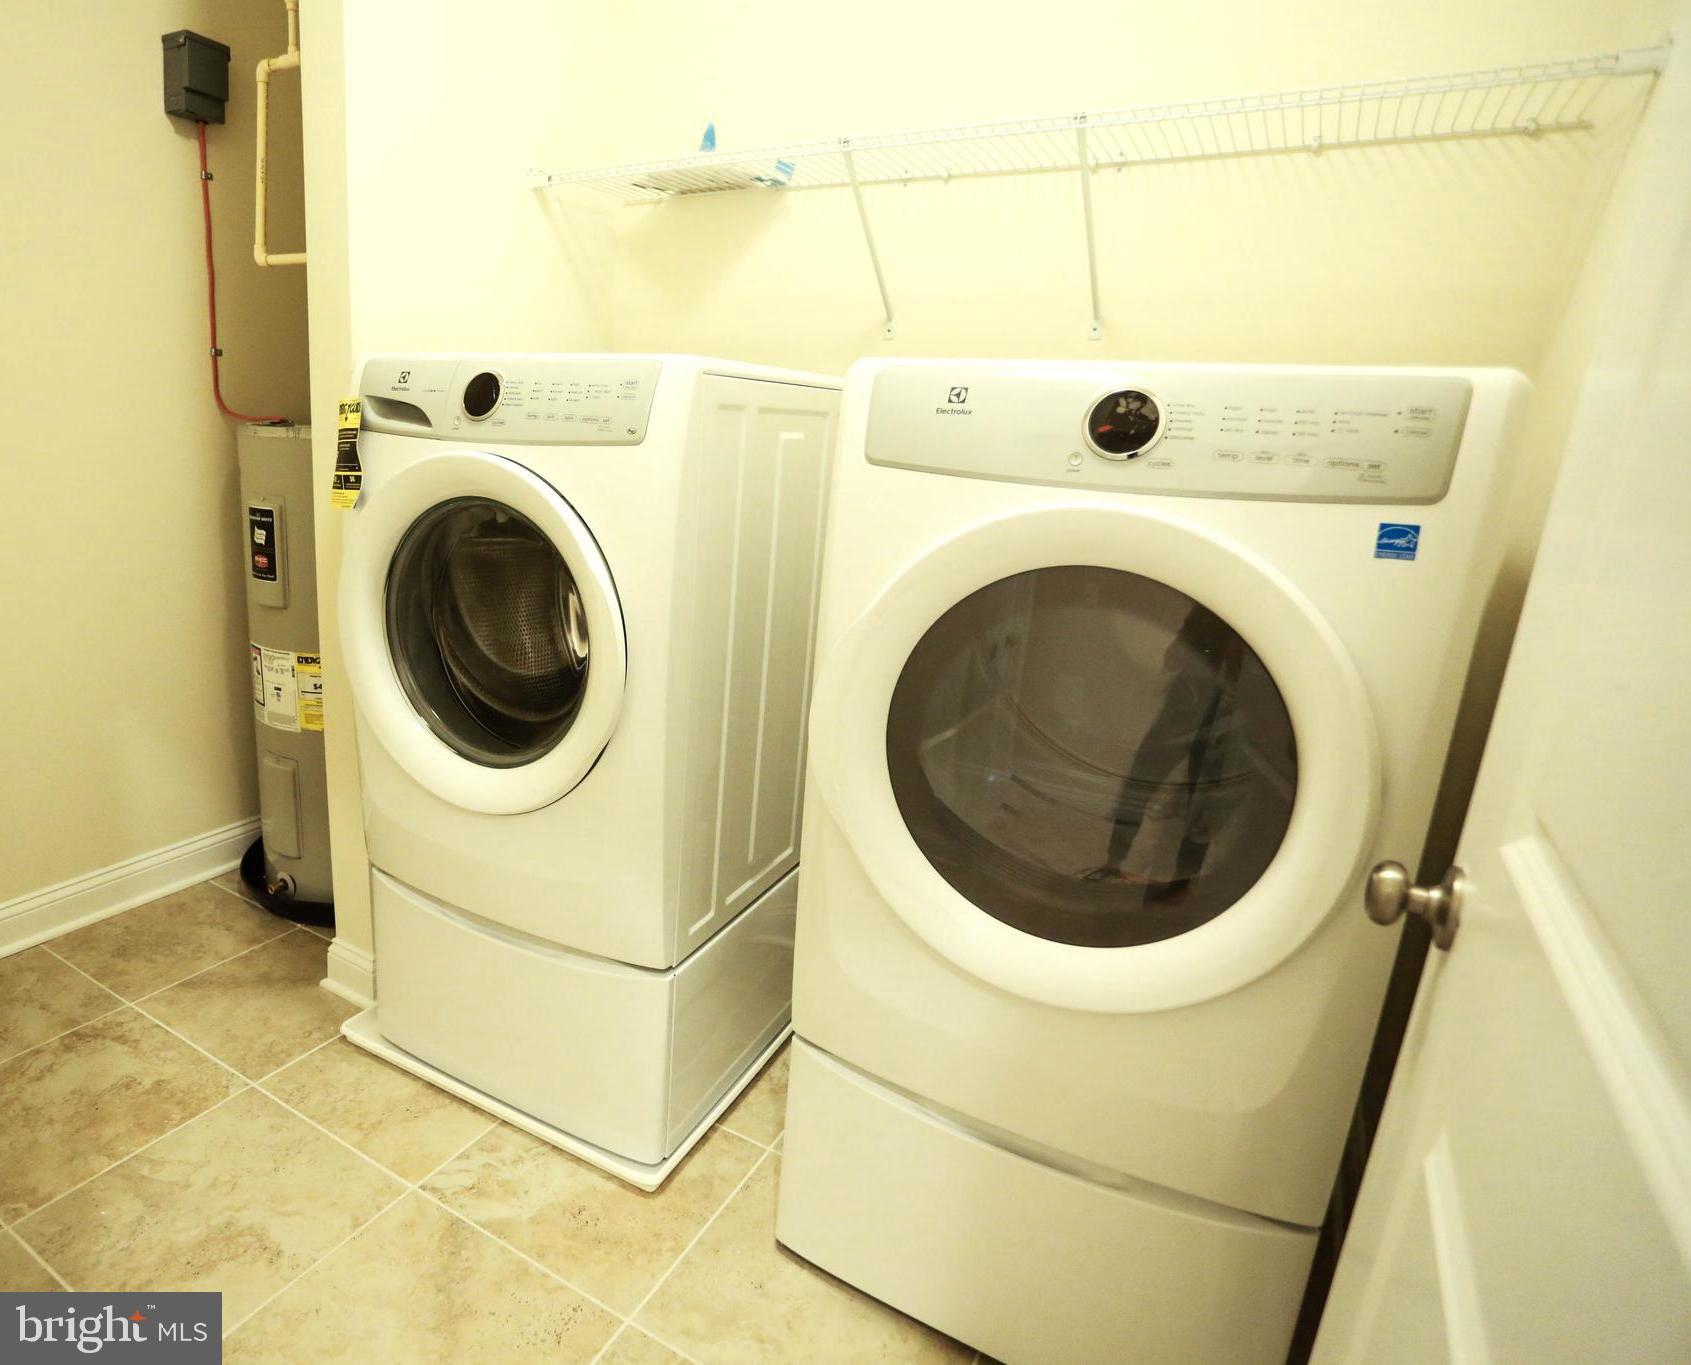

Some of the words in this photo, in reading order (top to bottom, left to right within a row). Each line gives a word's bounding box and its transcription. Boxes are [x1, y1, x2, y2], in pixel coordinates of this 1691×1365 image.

[935, 407, 973, 416] Electrolux
[1217, 453, 1239, 461] temp
[1326, 460, 1360, 470] options
